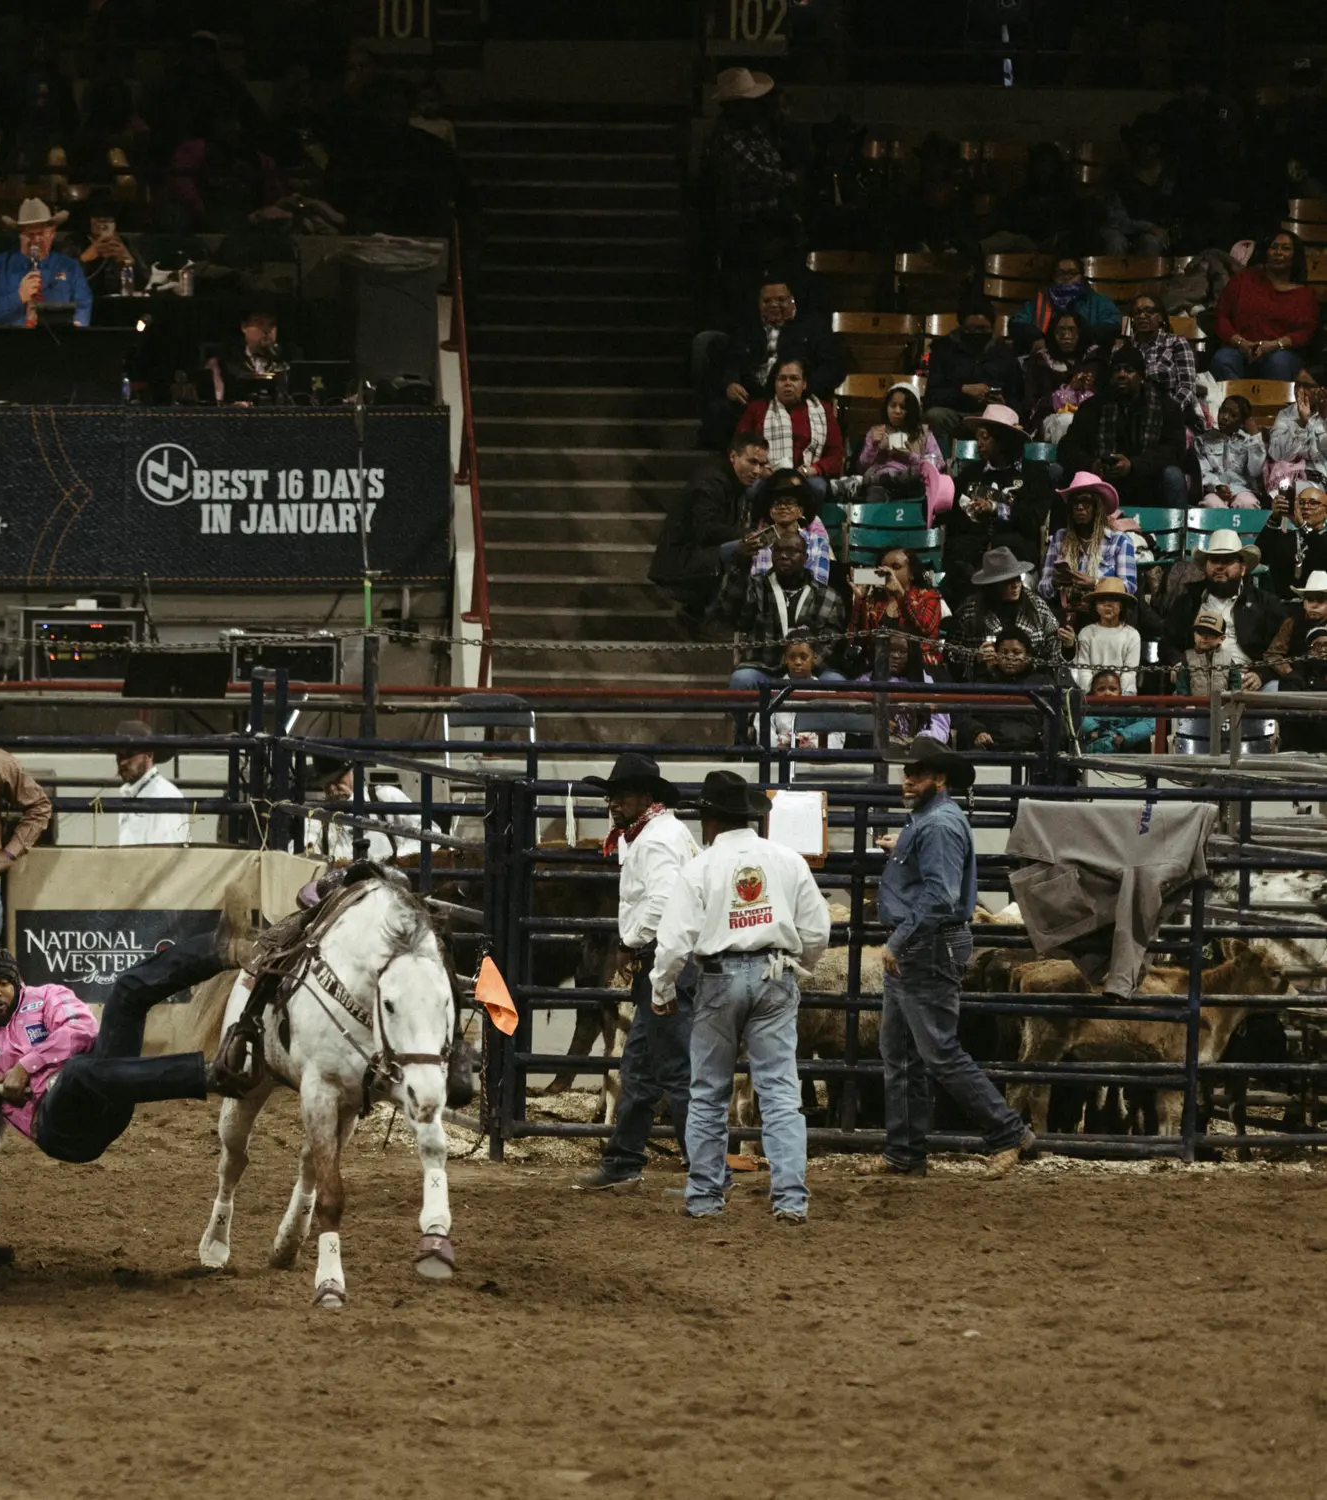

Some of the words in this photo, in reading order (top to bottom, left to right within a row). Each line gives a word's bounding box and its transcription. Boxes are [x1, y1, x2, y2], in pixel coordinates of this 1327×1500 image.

[379, 0, 430, 39] 101
[730, 0, 787, 41] 102
[192, 469, 269, 500] BEST
[277, 469, 304, 500] 16
[312, 468, 385, 500] DAYS
[200, 503, 233, 534] IN
[240, 503, 377, 534] JANUARY
[895, 508, 905, 522] 2
[1232, 513, 1241, 528] 5
[729, 912, 773, 930] RODEO
[24, 928, 143, 954] NATIONAL
[317, 965, 336, 990] PAT
